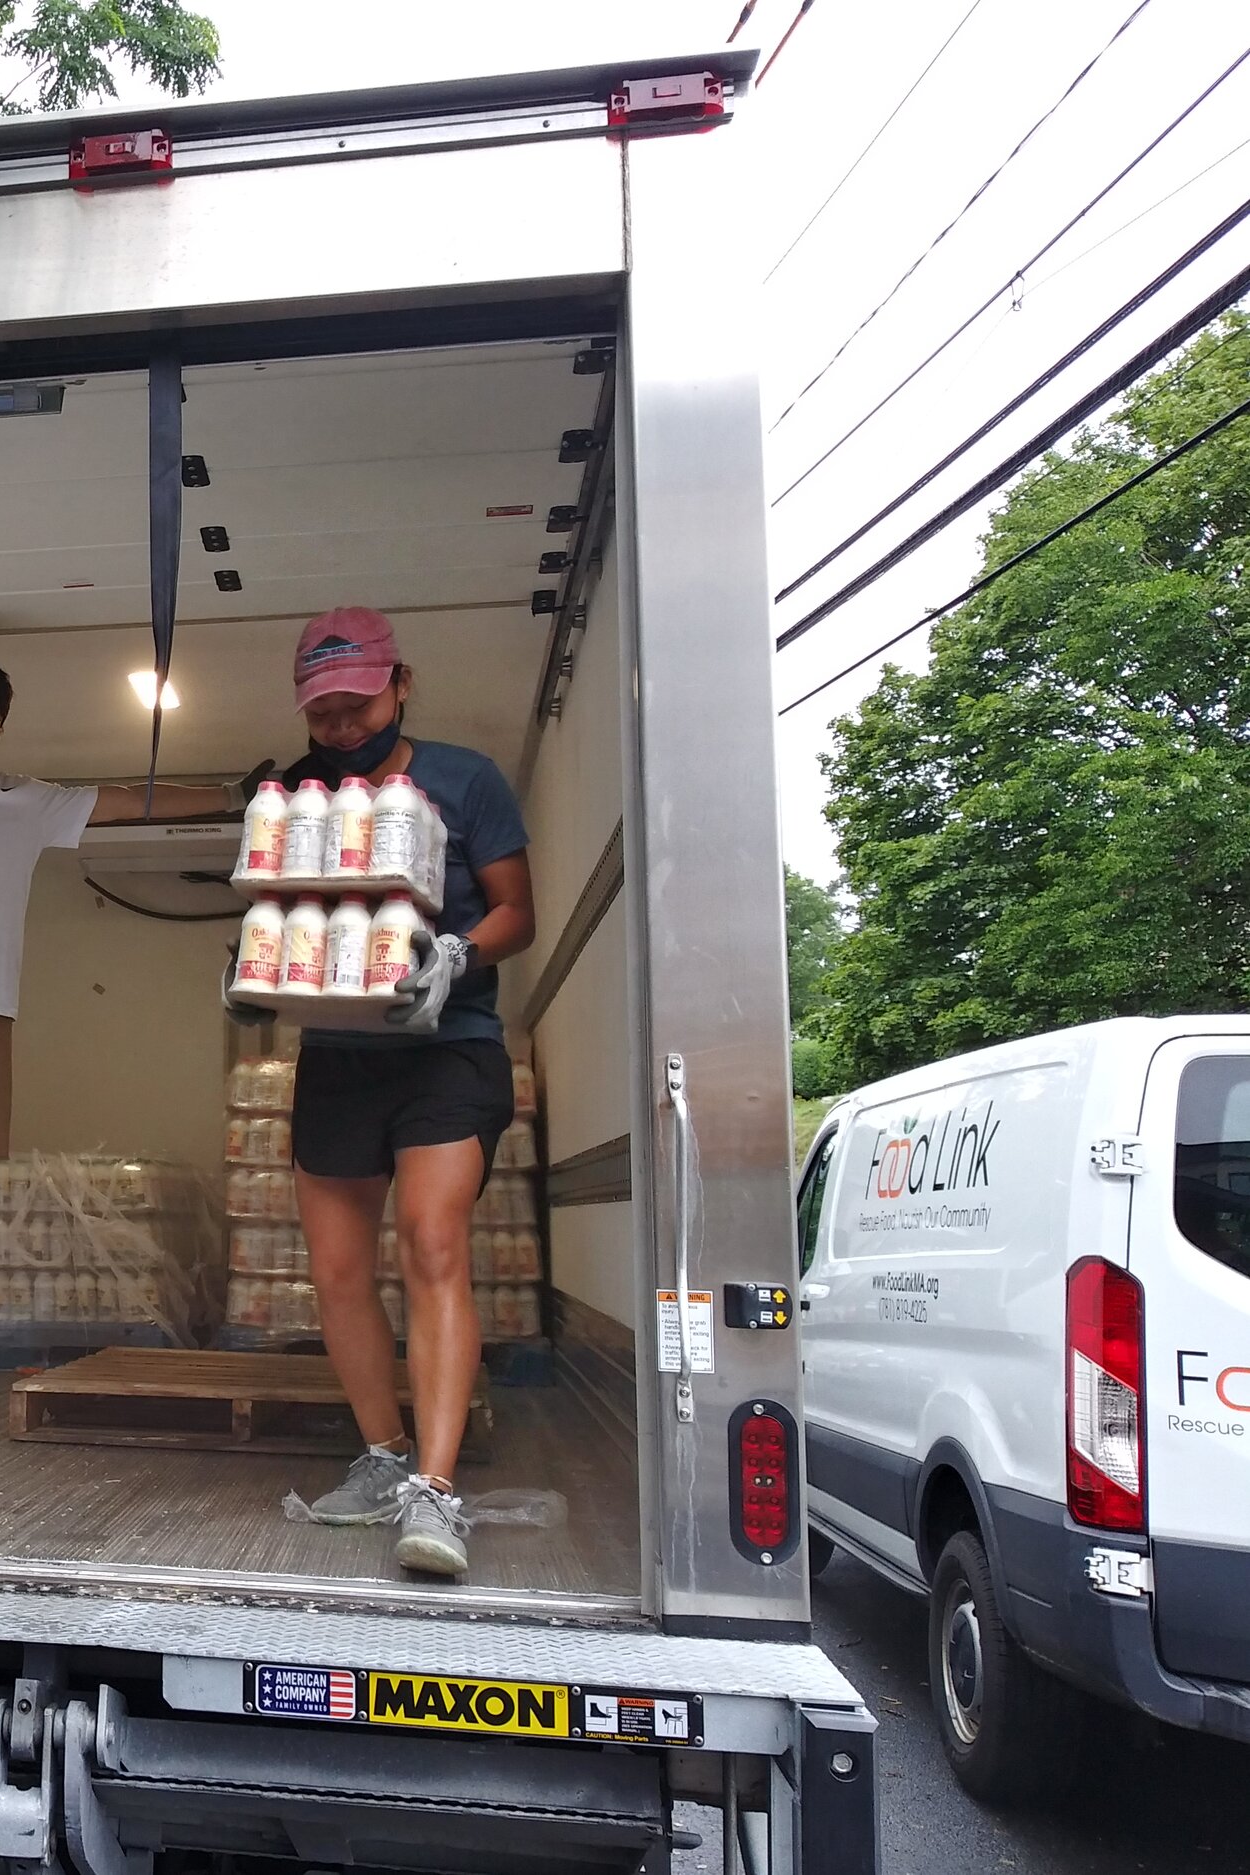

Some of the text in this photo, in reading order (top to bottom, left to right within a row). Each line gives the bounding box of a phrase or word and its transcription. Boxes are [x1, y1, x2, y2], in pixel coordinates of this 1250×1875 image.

[865, 1100, 1001, 1201] Food Link
[924, 1205, 940, 1229] Our
[940, 1202, 992, 1232] Community
[1168, 1414, 1244, 1436] Rescue
[275, 1671, 327, 1687] AMERICAN
[275, 1685, 326, 1703] COMPANY
[374, 1677, 556, 1729] MAXON
[275, 1701, 327, 1712] FAMILY OWNED
